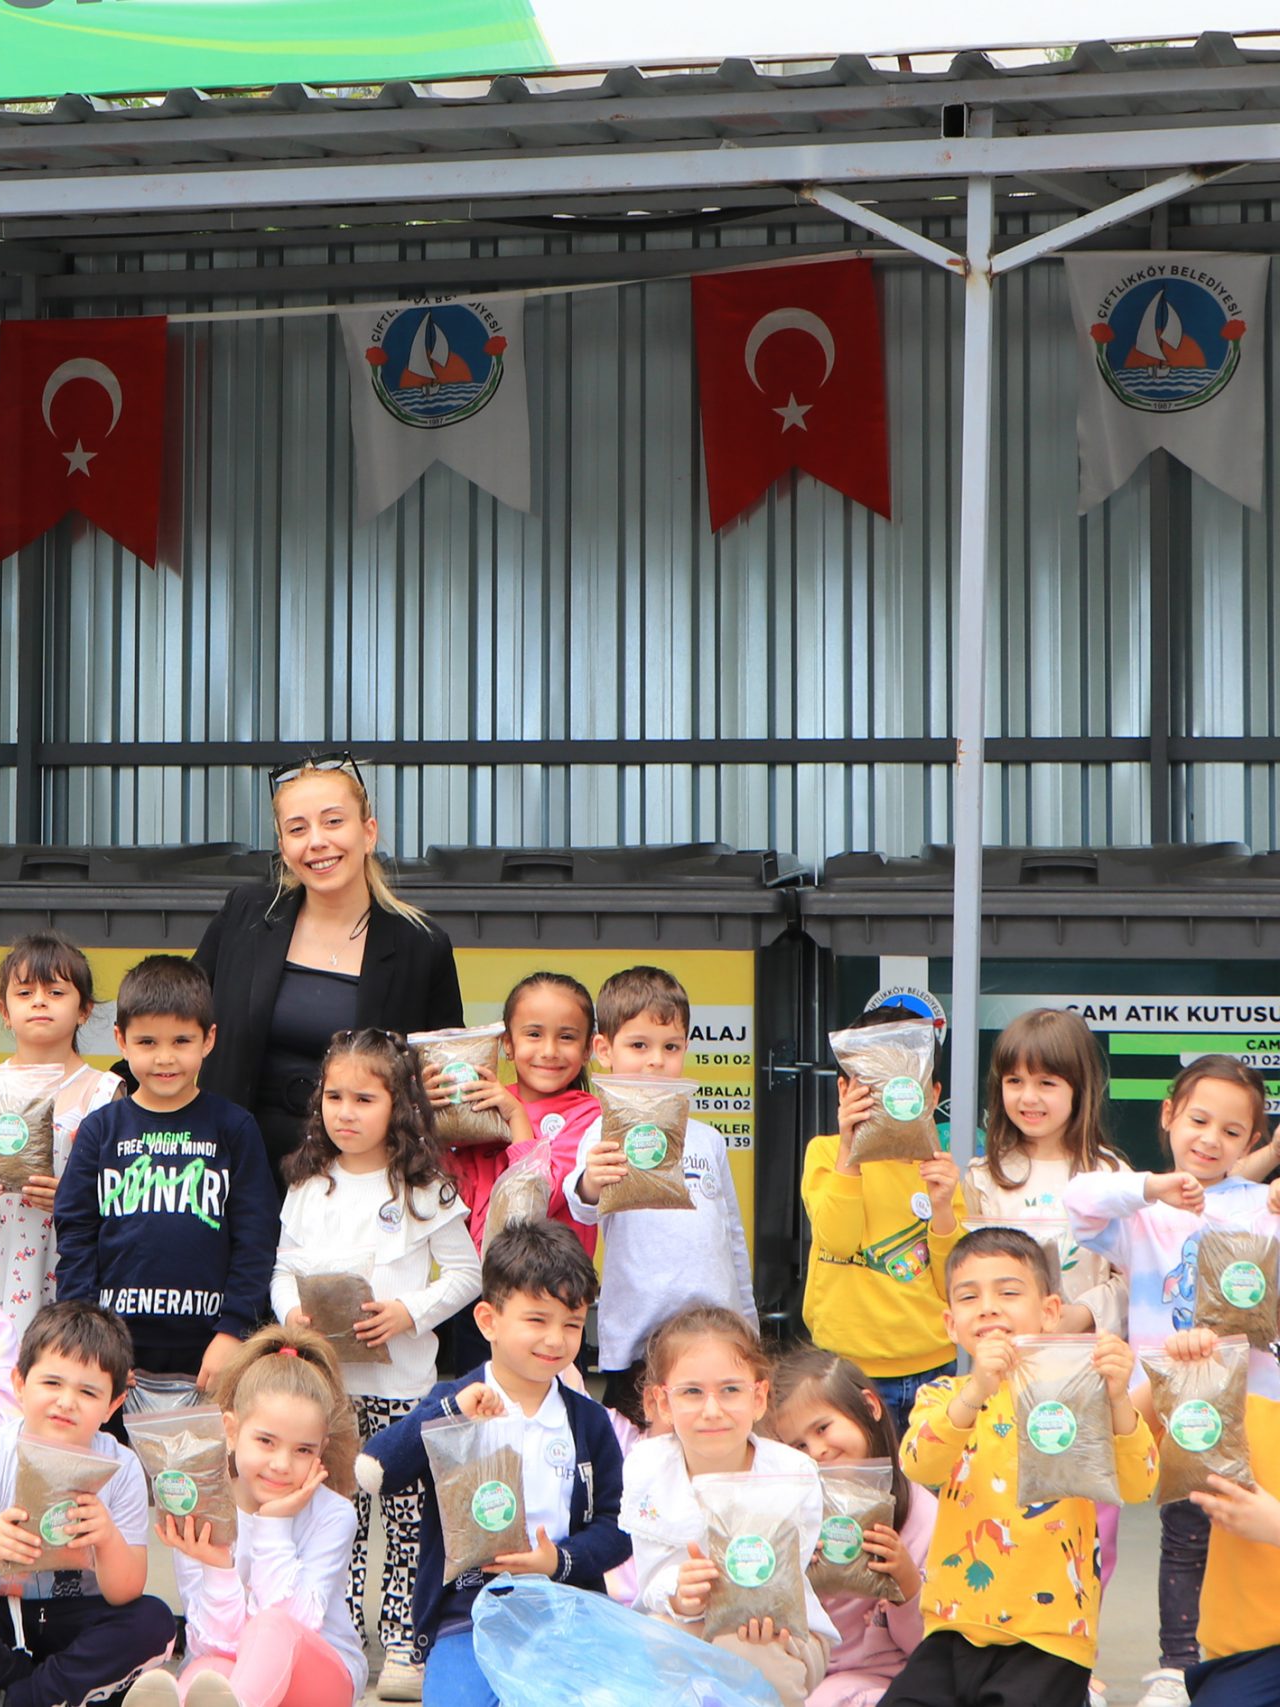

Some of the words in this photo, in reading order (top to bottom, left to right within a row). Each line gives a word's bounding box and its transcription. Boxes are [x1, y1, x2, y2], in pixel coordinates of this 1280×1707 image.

[1097, 265, 1166, 319] ÇİFTLİKKÖY
[1170, 265, 1242, 317] BELEDİYESİ
[1125, 1005, 1180, 1022] ATIK
[1187, 1006, 1280, 1023] KUTUSU
[689, 1026, 746, 1041] ALAJ
[1246, 1039, 1280, 1050] CAM
[695, 1054, 709, 1064] 15
[713, 1054, 728, 1065] 01
[733, 1055, 750, 1065] 02
[1262, 1055, 1280, 1065] 02
[695, 1100, 709, 1110] 15
[714, 1100, 728, 1110] 01
[733, 1100, 750, 1110] 02
[142, 1131, 191, 1145] IMAGINE
[734, 1137, 750, 1147] 39
[117, 1138, 143, 1157] FREE
[148, 1140, 178, 1156] YOUR
[181, 1141, 217, 1158] MIND!
[115, 1288, 223, 1317] GENERATIO
